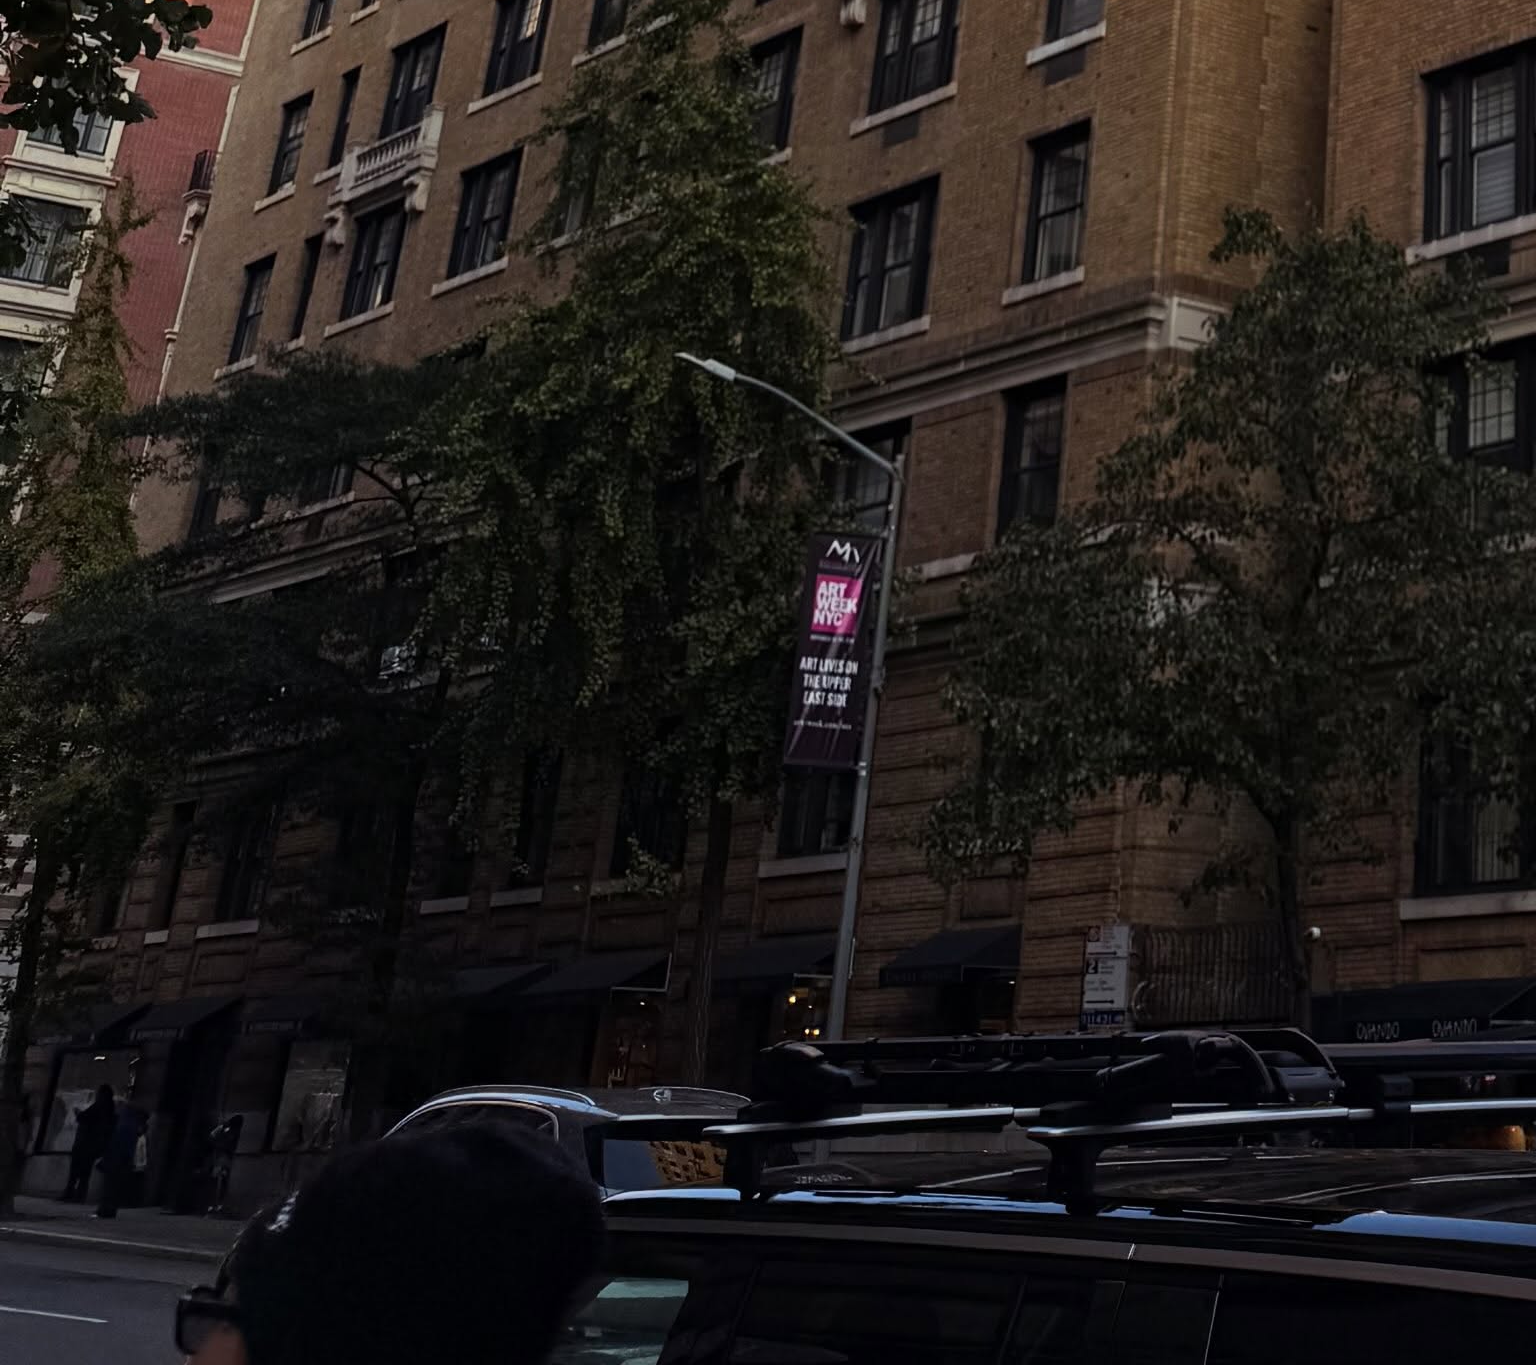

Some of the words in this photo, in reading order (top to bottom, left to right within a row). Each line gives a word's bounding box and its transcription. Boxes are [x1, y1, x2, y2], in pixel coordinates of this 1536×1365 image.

[817, 580, 847, 598] ART
[816, 595, 858, 614] WEEK
[813, 610, 844, 627] NYC
[799, 656, 818, 672] ART
[803, 673, 821, 689] THE
[822, 675, 852, 692] UPPER
[826, 692, 848, 708] SIDE
[1355, 1021, 1400, 1040] OVANDO
[1431, 1019, 1479, 1038] OVANDO
